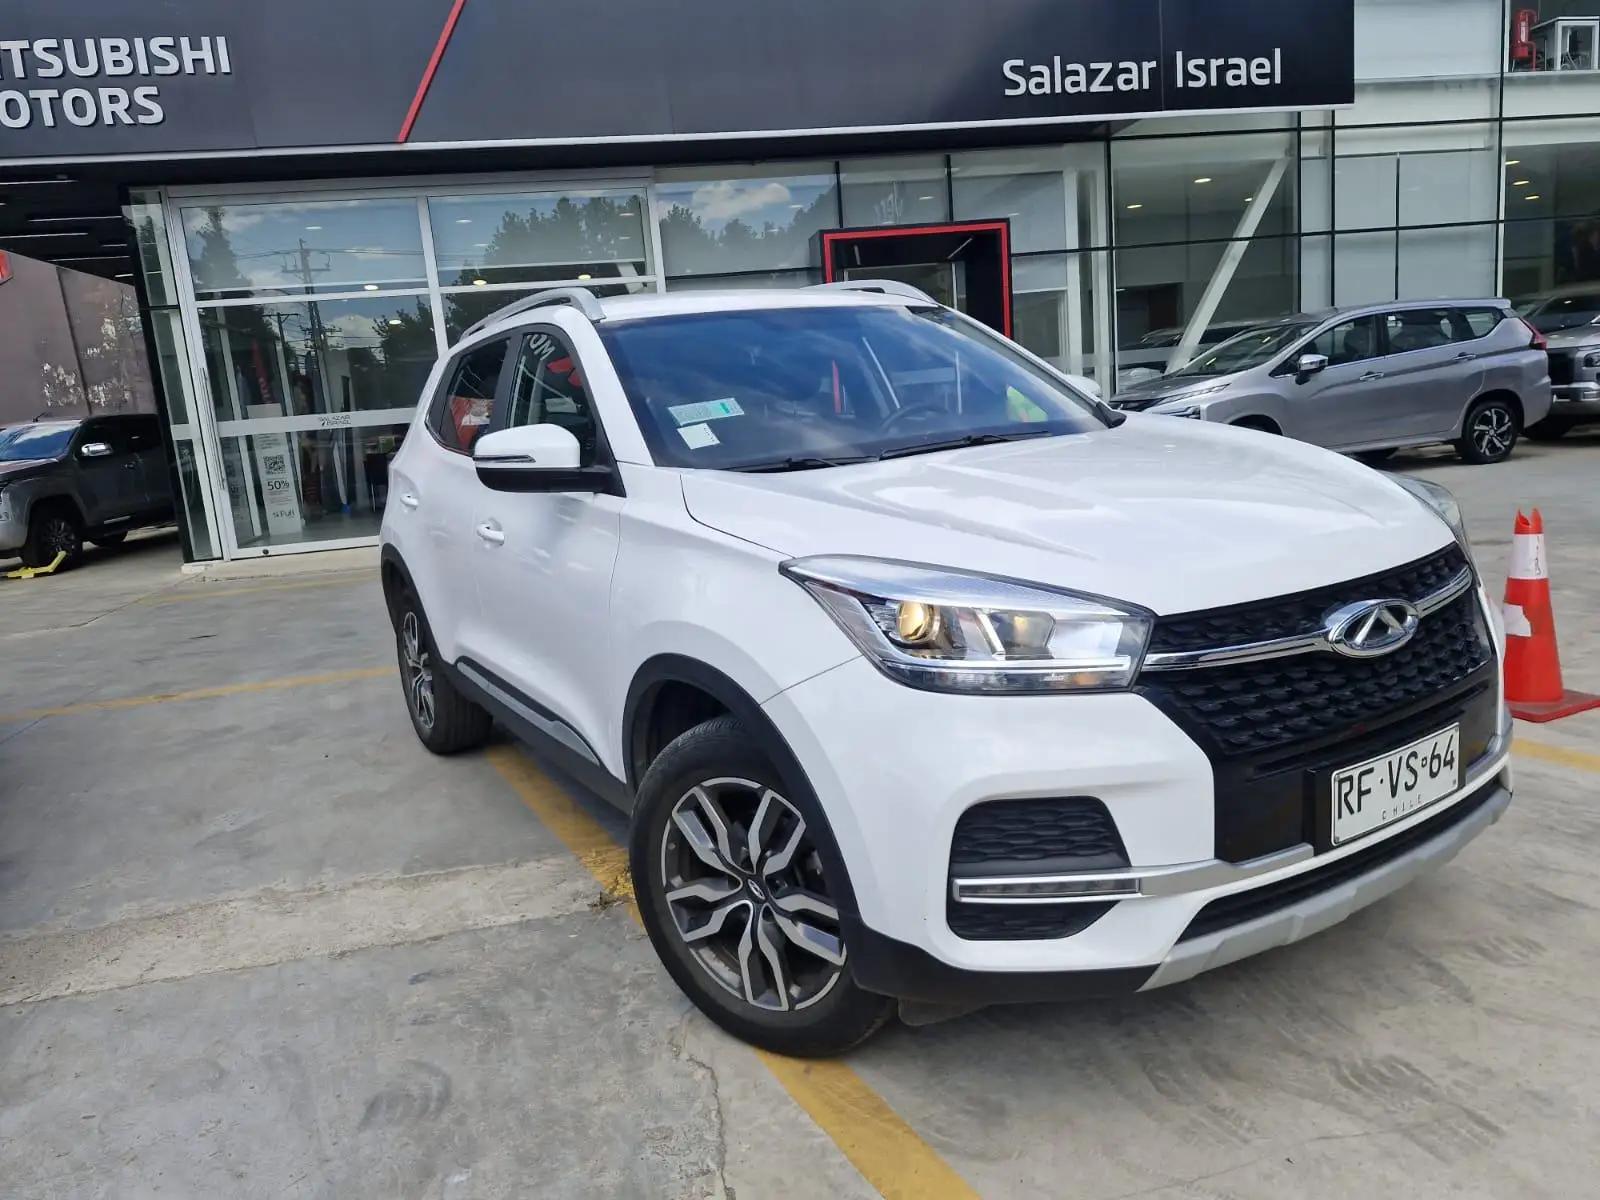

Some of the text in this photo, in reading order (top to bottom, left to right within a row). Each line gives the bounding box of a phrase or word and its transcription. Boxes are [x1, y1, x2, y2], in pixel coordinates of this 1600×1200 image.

[0, 36, 231, 79] TSUBISHI
[1002, 47, 1281, 96] Salazar Israel
[0, 86, 165, 128] OTORS
[267, 480, 290, 490] 50%
[1381, 794, 1422, 820] CHILE
